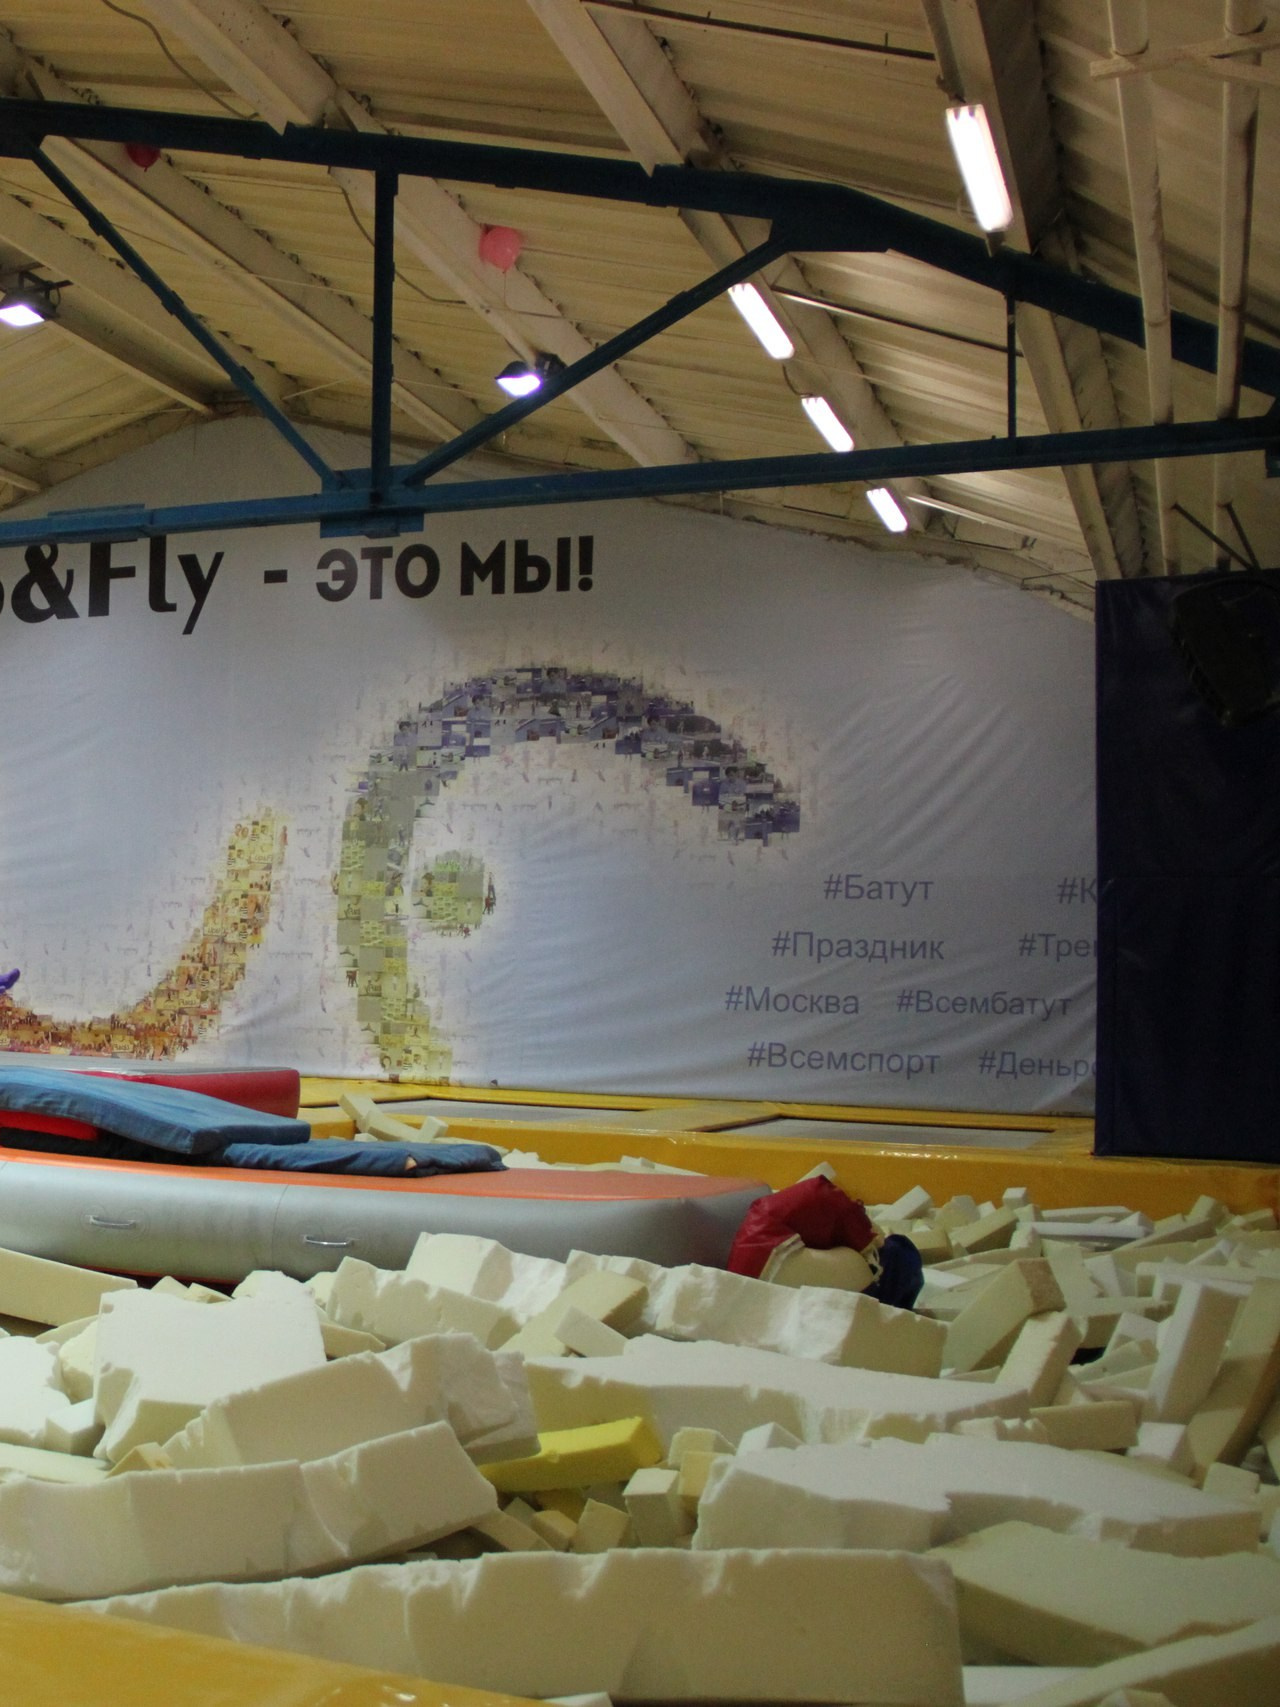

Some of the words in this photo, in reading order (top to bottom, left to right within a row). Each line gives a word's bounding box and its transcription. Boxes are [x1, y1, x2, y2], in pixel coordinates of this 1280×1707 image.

[823, 873, 934, 907] #Батут
[771, 930, 945, 964] #Праздник
[1018, 932, 1098, 962] #Тре
[725, 985, 860, 1014] #Москва
[896, 989, 1072, 1022] #Всембатут
[747, 1041, 941, 1080] #Всемспорт
